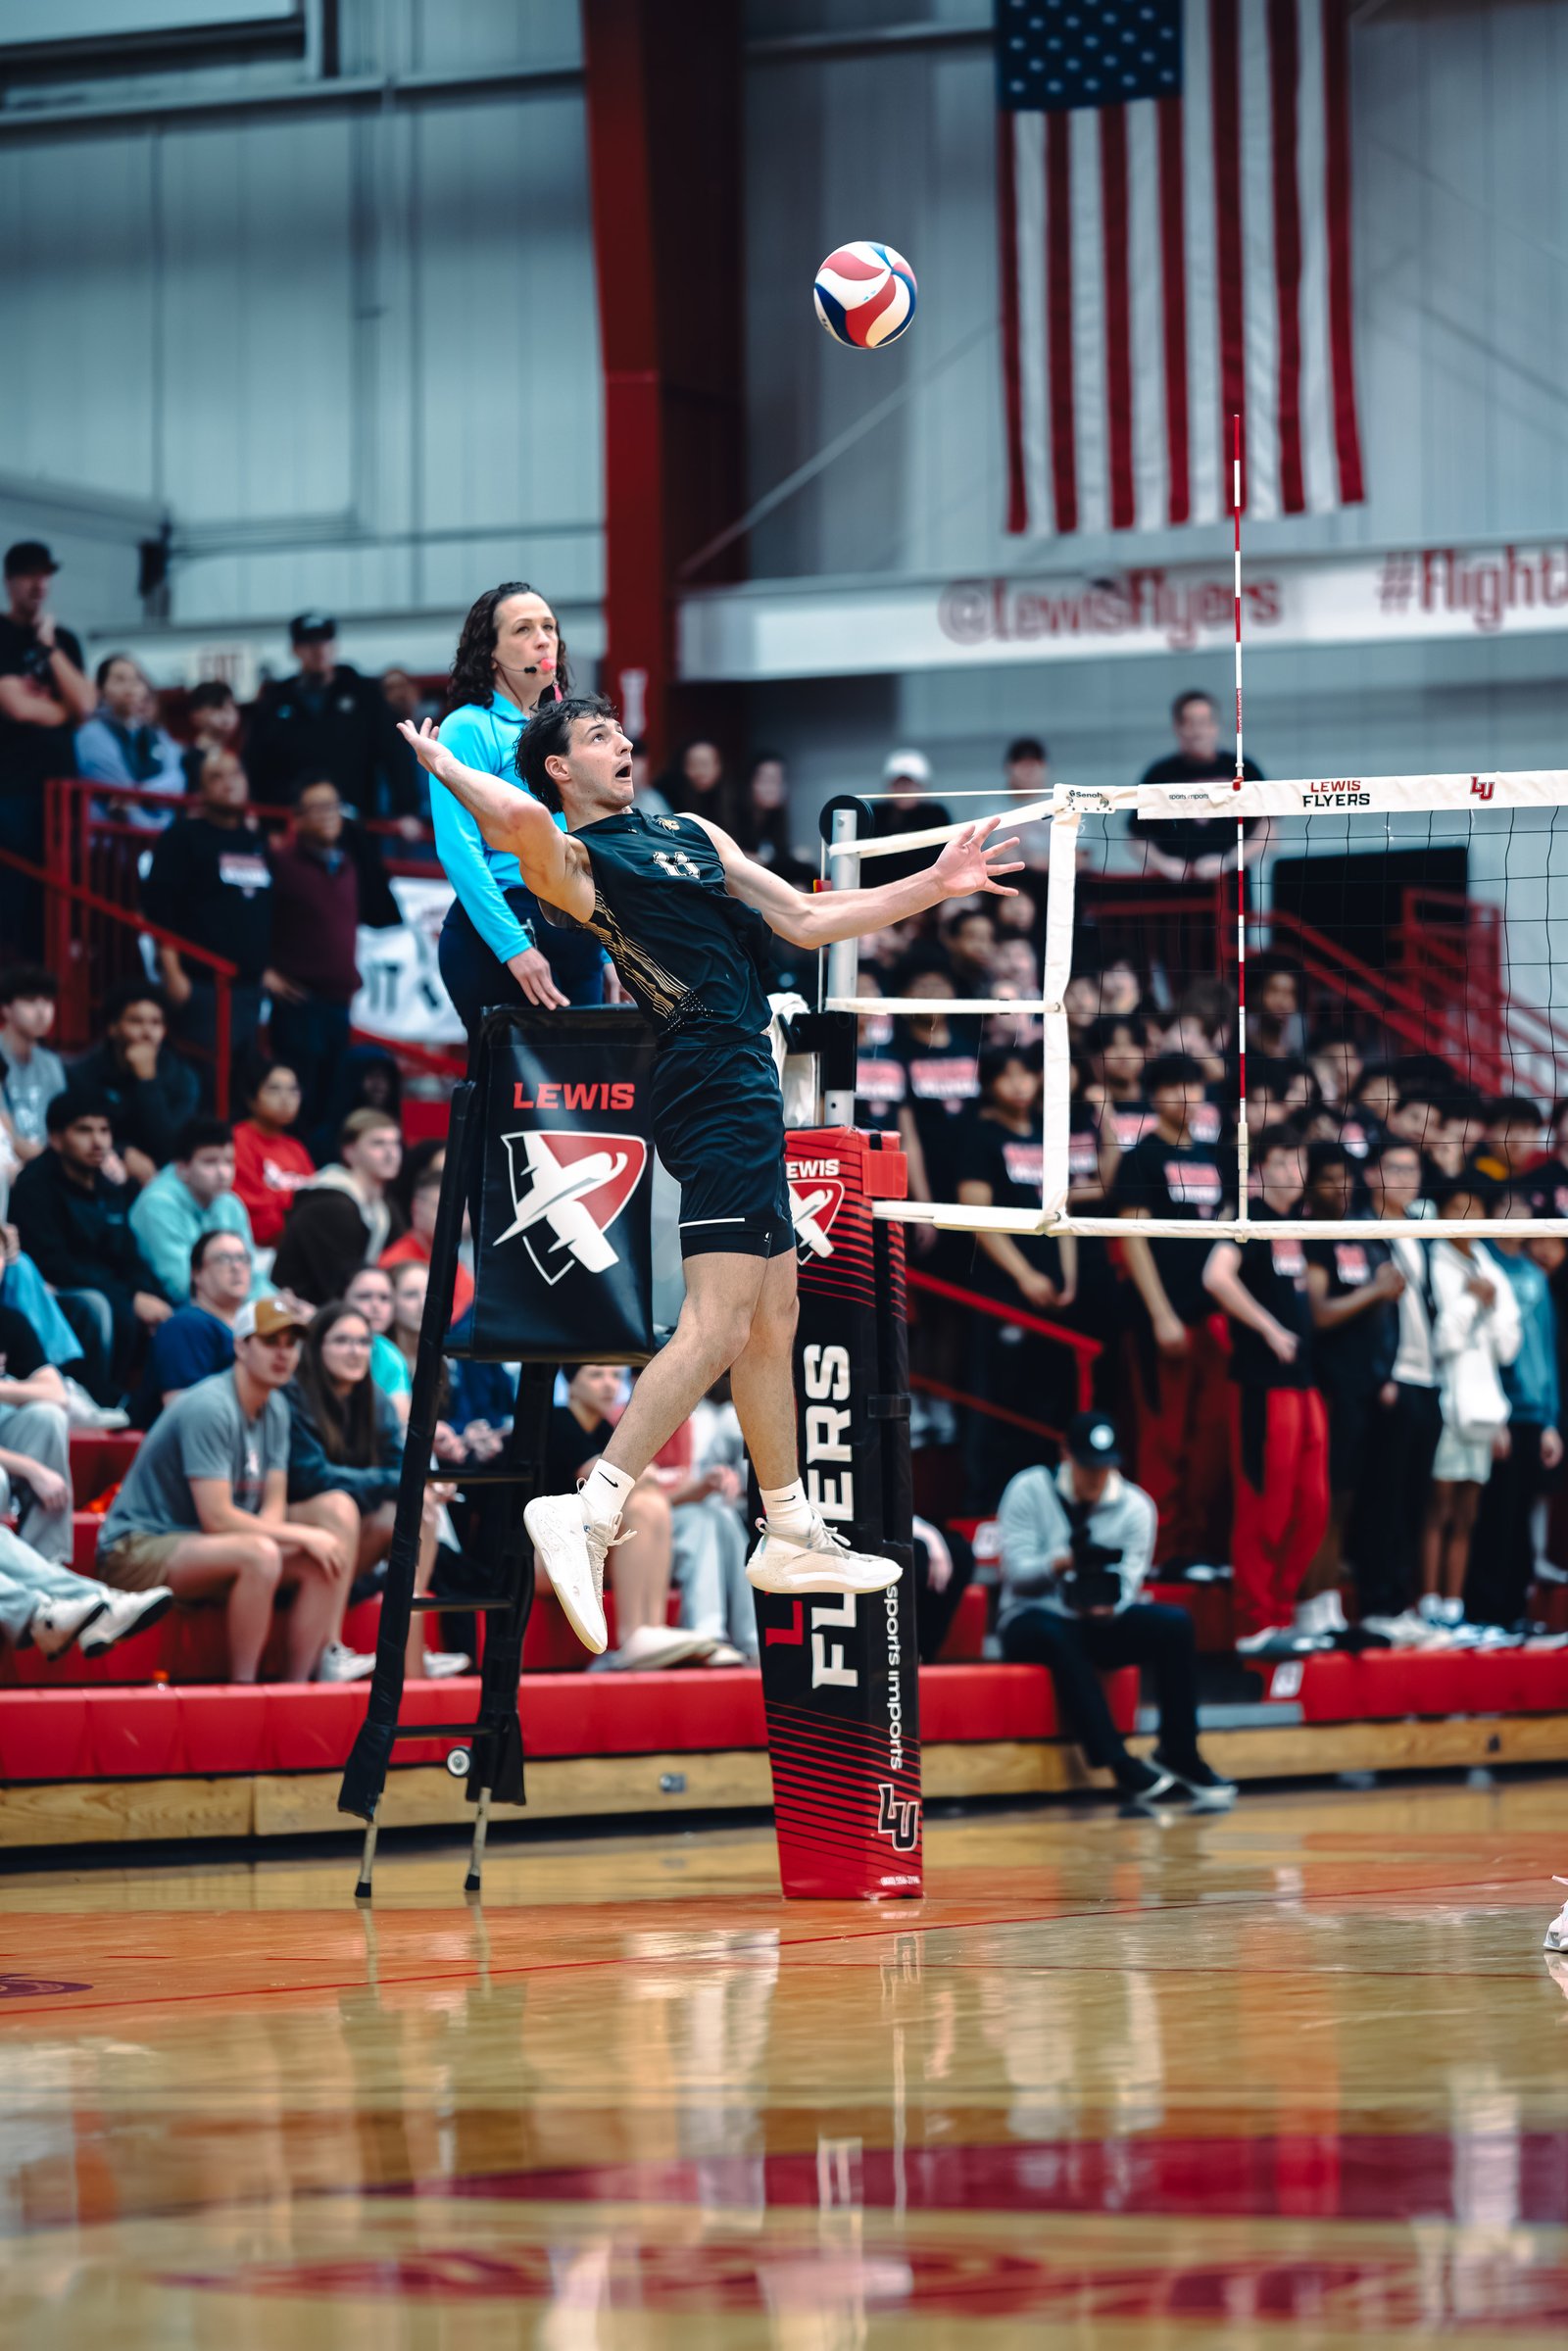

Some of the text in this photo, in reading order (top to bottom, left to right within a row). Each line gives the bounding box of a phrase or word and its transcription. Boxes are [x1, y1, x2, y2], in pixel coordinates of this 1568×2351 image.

[1376, 544, 1568, 631] #Flight
[1302, 793, 1371, 808] FLYERS
[1310, 780, 1361, 793] LEWIS
[1470, 775, 1495, 802] LU
[513, 1082, 636, 1110] LEWIS
[786, 1158, 840, 1179] EWIS
[803, 1344, 858, 1690] FLERS
[884, 1585, 904, 1770] sports imports
[878, 1784, 919, 1851] LU
